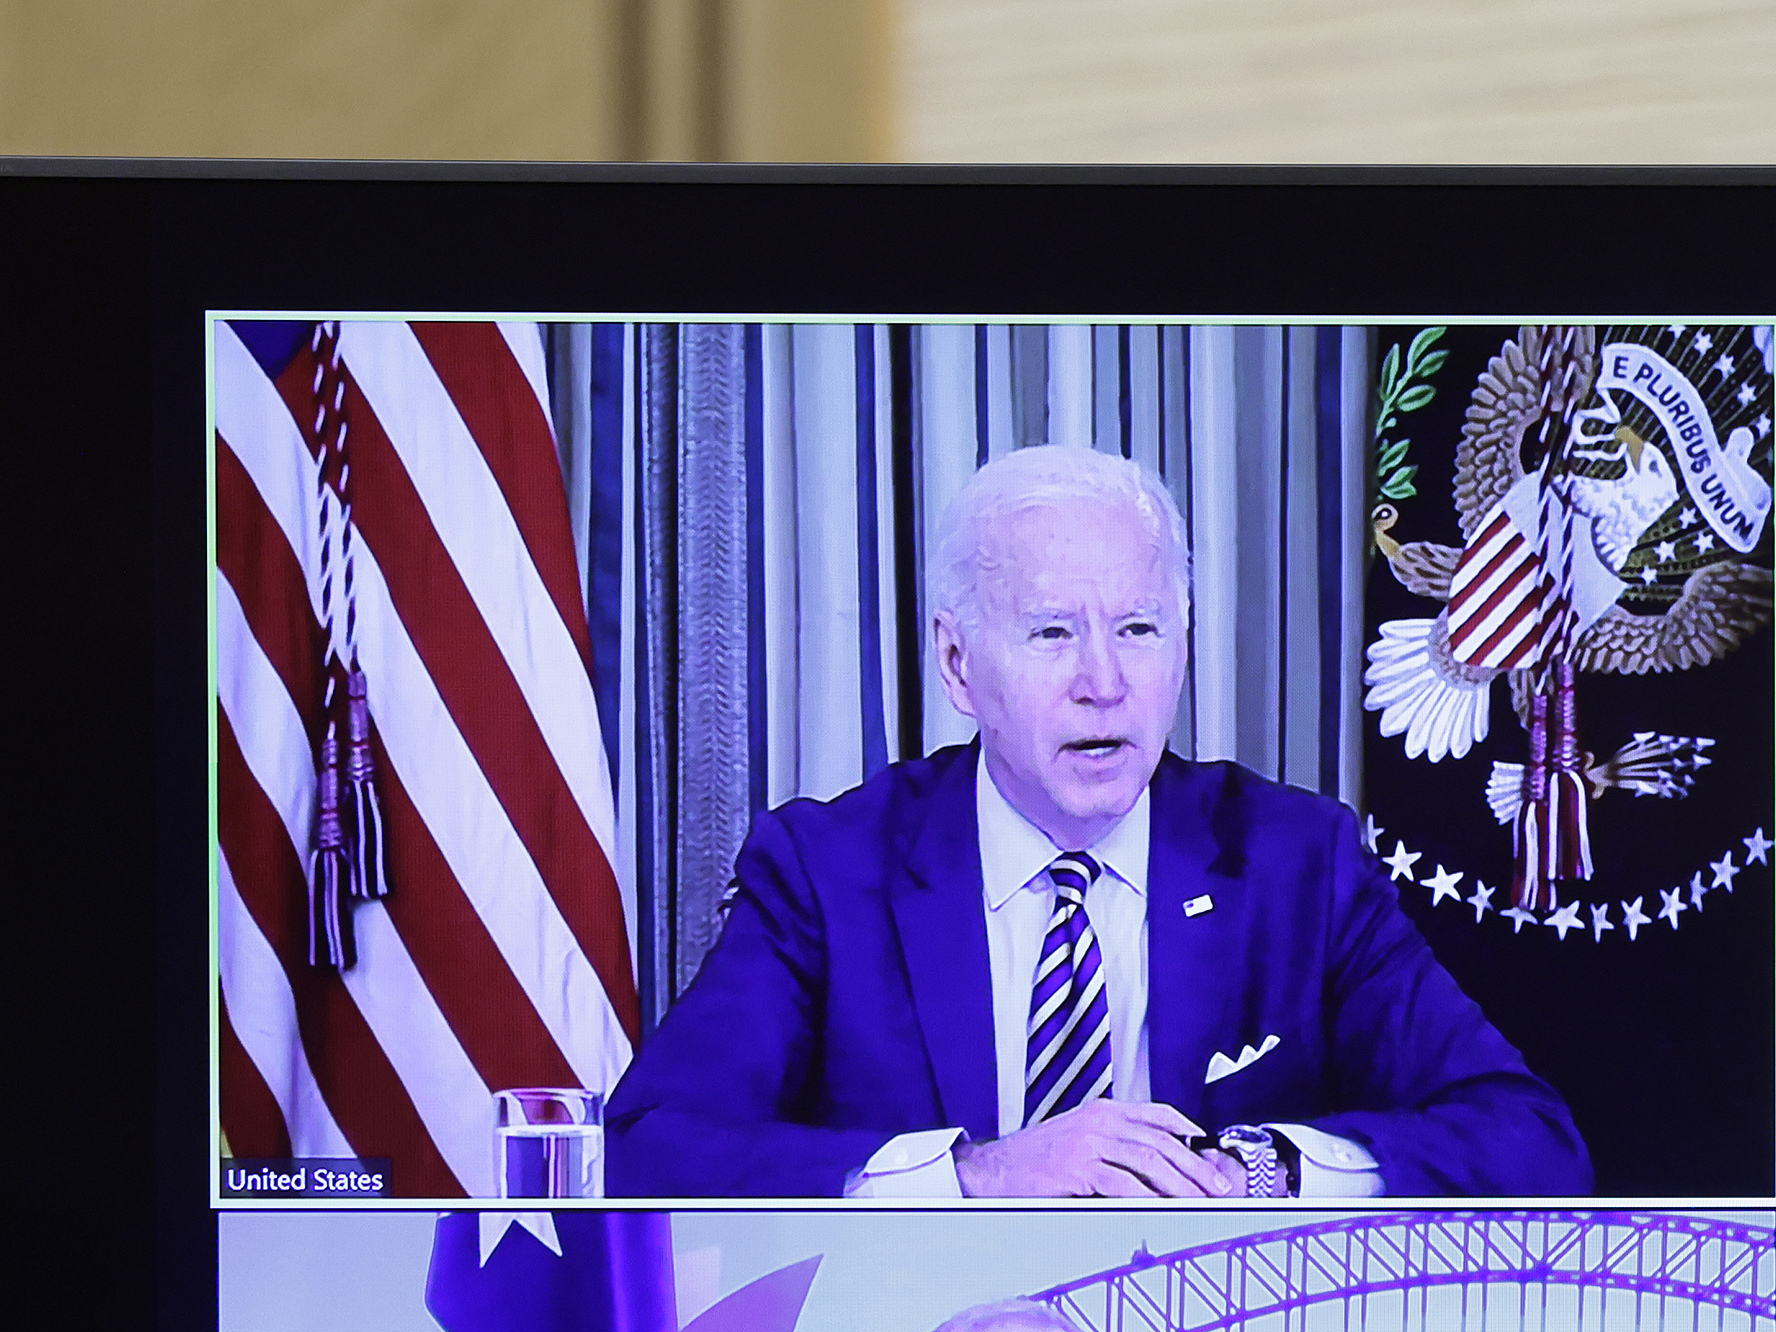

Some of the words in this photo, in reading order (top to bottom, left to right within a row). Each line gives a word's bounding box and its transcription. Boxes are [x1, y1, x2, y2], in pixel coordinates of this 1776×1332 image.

[1612, 356, 1630, 379] E
[1632, 362, 1711, 474] PLURIBUS
[1700, 473, 1754, 539] UNUM
[227, 1167, 306, 1191] United
[313, 1168, 384, 1191] States
